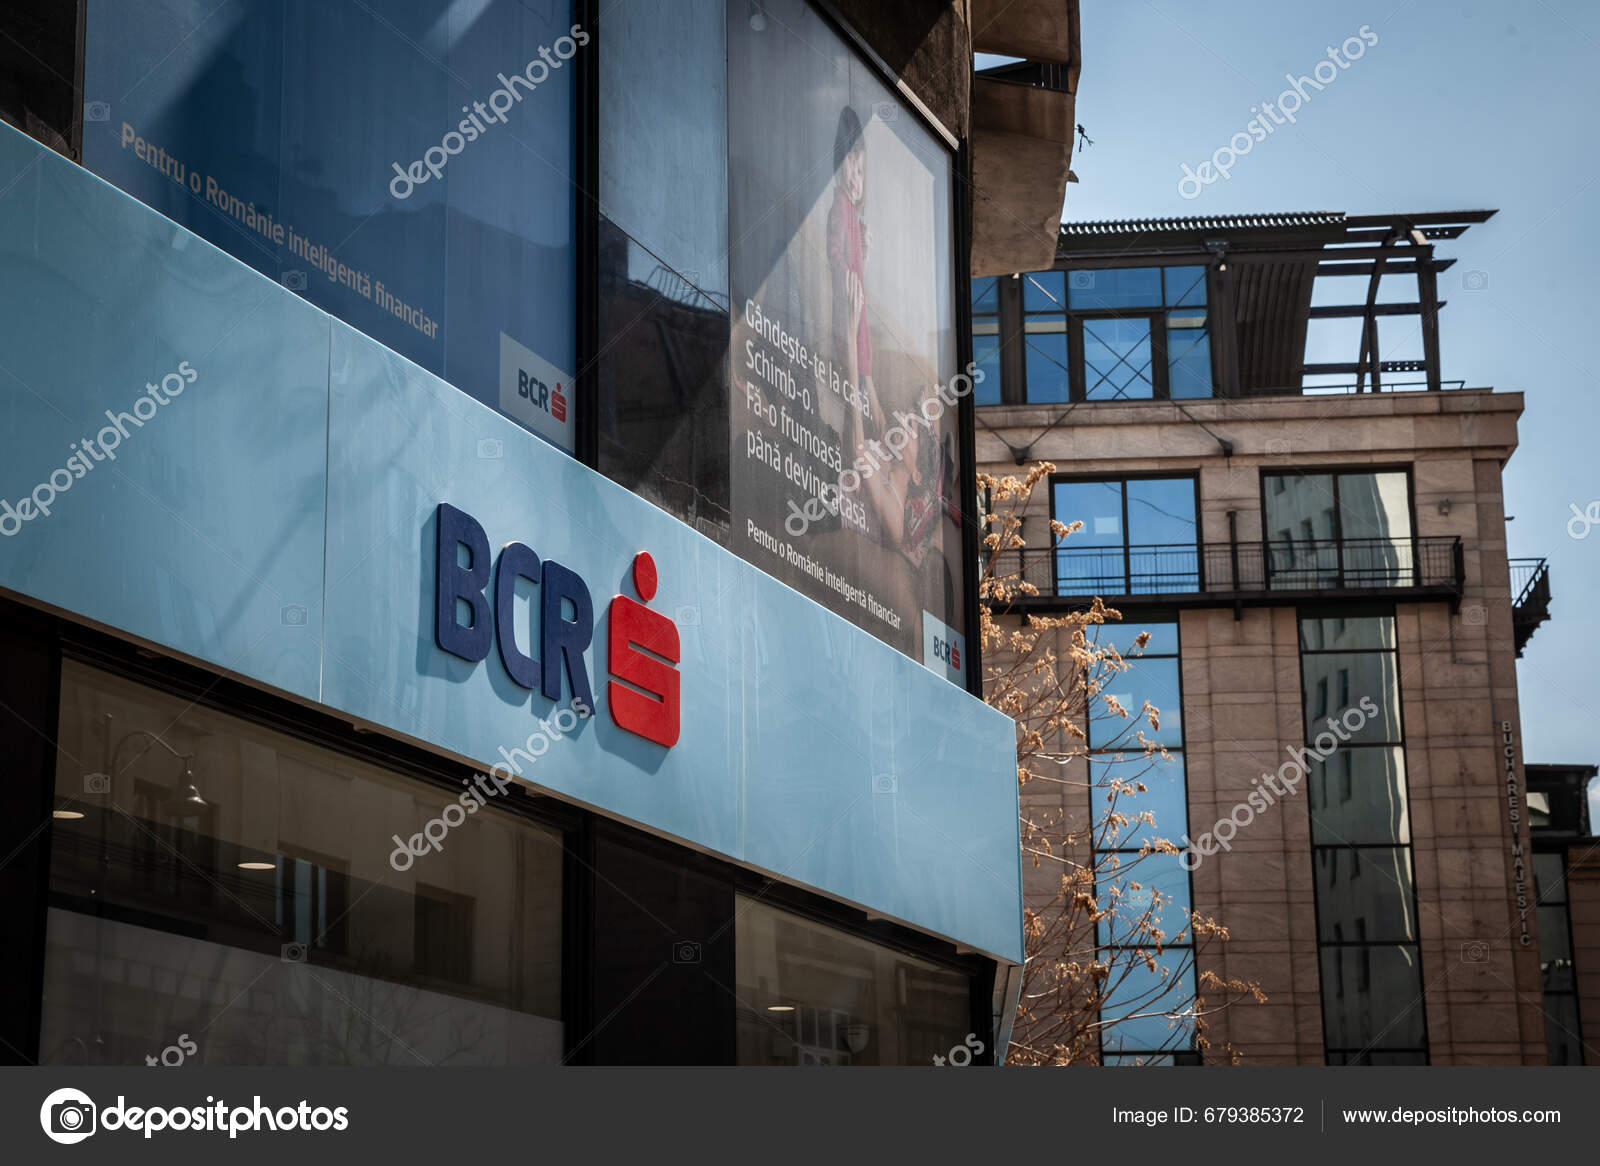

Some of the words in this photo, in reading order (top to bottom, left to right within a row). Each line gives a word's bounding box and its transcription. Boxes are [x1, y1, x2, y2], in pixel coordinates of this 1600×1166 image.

[121, 121, 185, 185] Pentru
[190, 171, 201, 193] o
[206, 175, 285, 245] Românie
[288, 225, 372, 300] inteligentă
[375, 280, 438, 340] financiar
[518, 367, 549, 413] BCR
[745, 339, 814, 415] Schimb-o.
[829, 361, 841, 395] la
[746, 380, 778, 428] Fă-o
[780, 405, 842, 474] frumoasă
[747, 429, 781, 473] până
[784, 452, 829, 505] devine
[434, 502, 595, 716] BCR
[747, 518, 778, 554] Pentru
[779, 543, 785, 558] o
[786, 543, 824, 583] Românie
[825, 567, 866, 609] inteligentă
[867, 593, 901, 630] financiar
[933, 635, 951, 665] BCR
[1502, 720, 1520, 833] BUCHAREST
[1512, 843, 1531, 946] MAJESTIC
